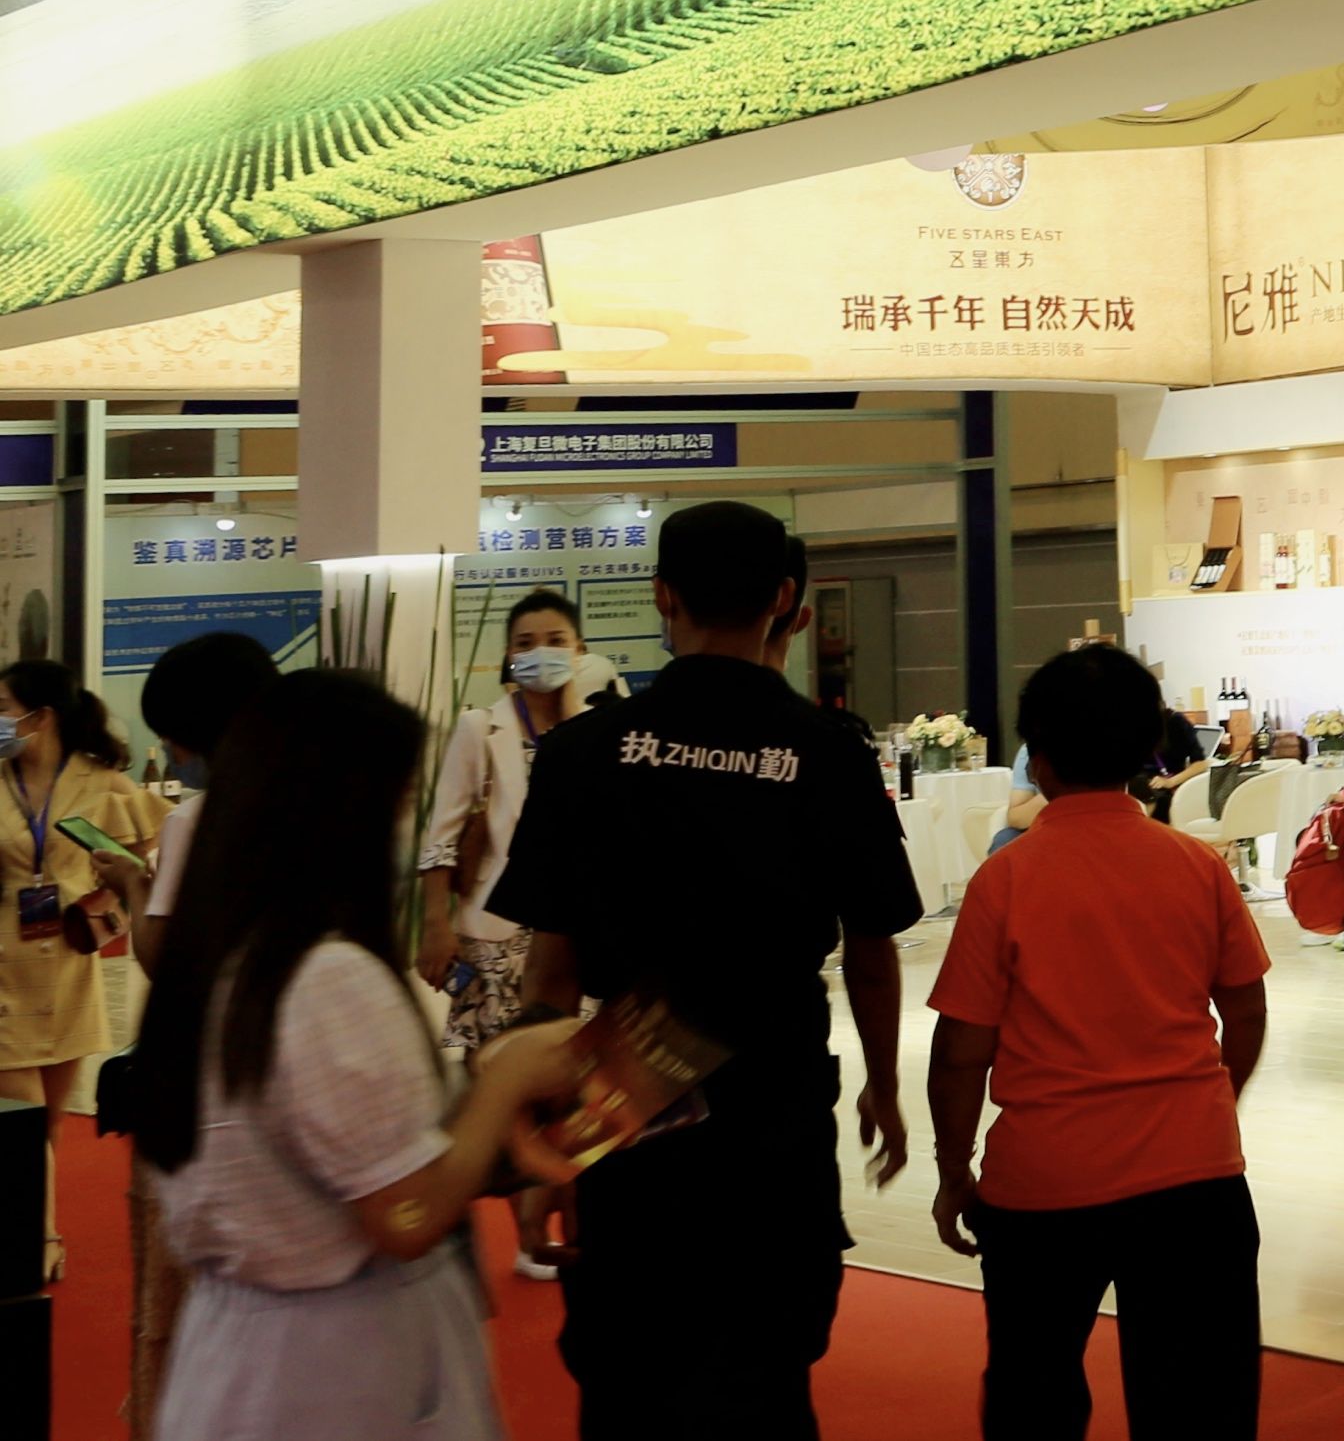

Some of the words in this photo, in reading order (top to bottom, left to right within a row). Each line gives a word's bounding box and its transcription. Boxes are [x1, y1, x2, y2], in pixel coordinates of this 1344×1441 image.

[841, 295, 985, 332] 瑞承千年
[1002, 295, 1136, 332] 自然天成
[1222, 263, 1300, 343] 尼雅
